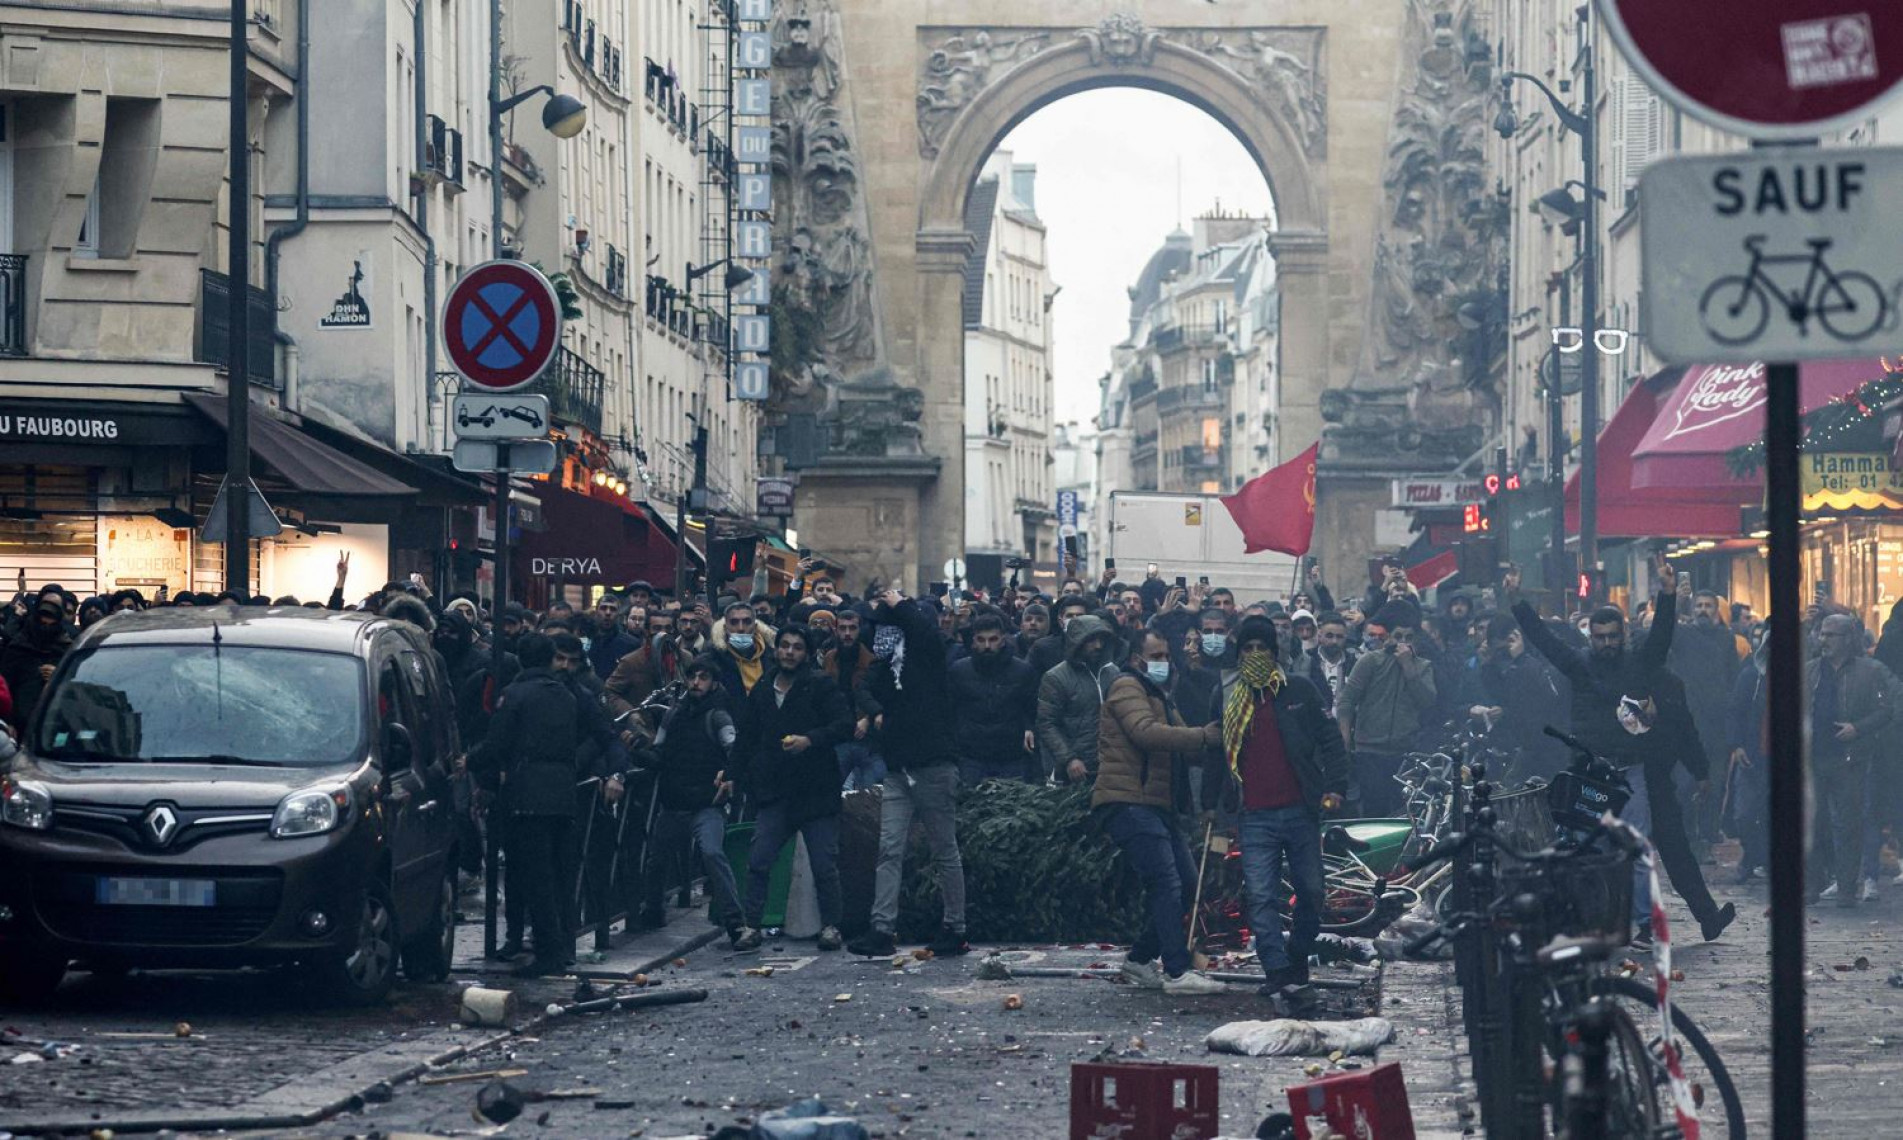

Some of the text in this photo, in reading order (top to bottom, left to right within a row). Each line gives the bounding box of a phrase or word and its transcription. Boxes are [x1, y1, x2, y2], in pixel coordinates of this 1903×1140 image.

[742, 137, 767, 153] DU
[1713, 164, 1865, 216] SAUF
[742, 178, 766, 396] PRADO
[1690, 380, 1761, 411] Lady
[16, 416, 118, 438] FAUBOURG
[1812, 455, 1885, 473] Hamma
[1821, 474, 1848, 488] Tel:
[1861, 474, 1876, 488] 01
[136, 529, 153, 541] LA
[532, 558, 601, 574] DERYA
